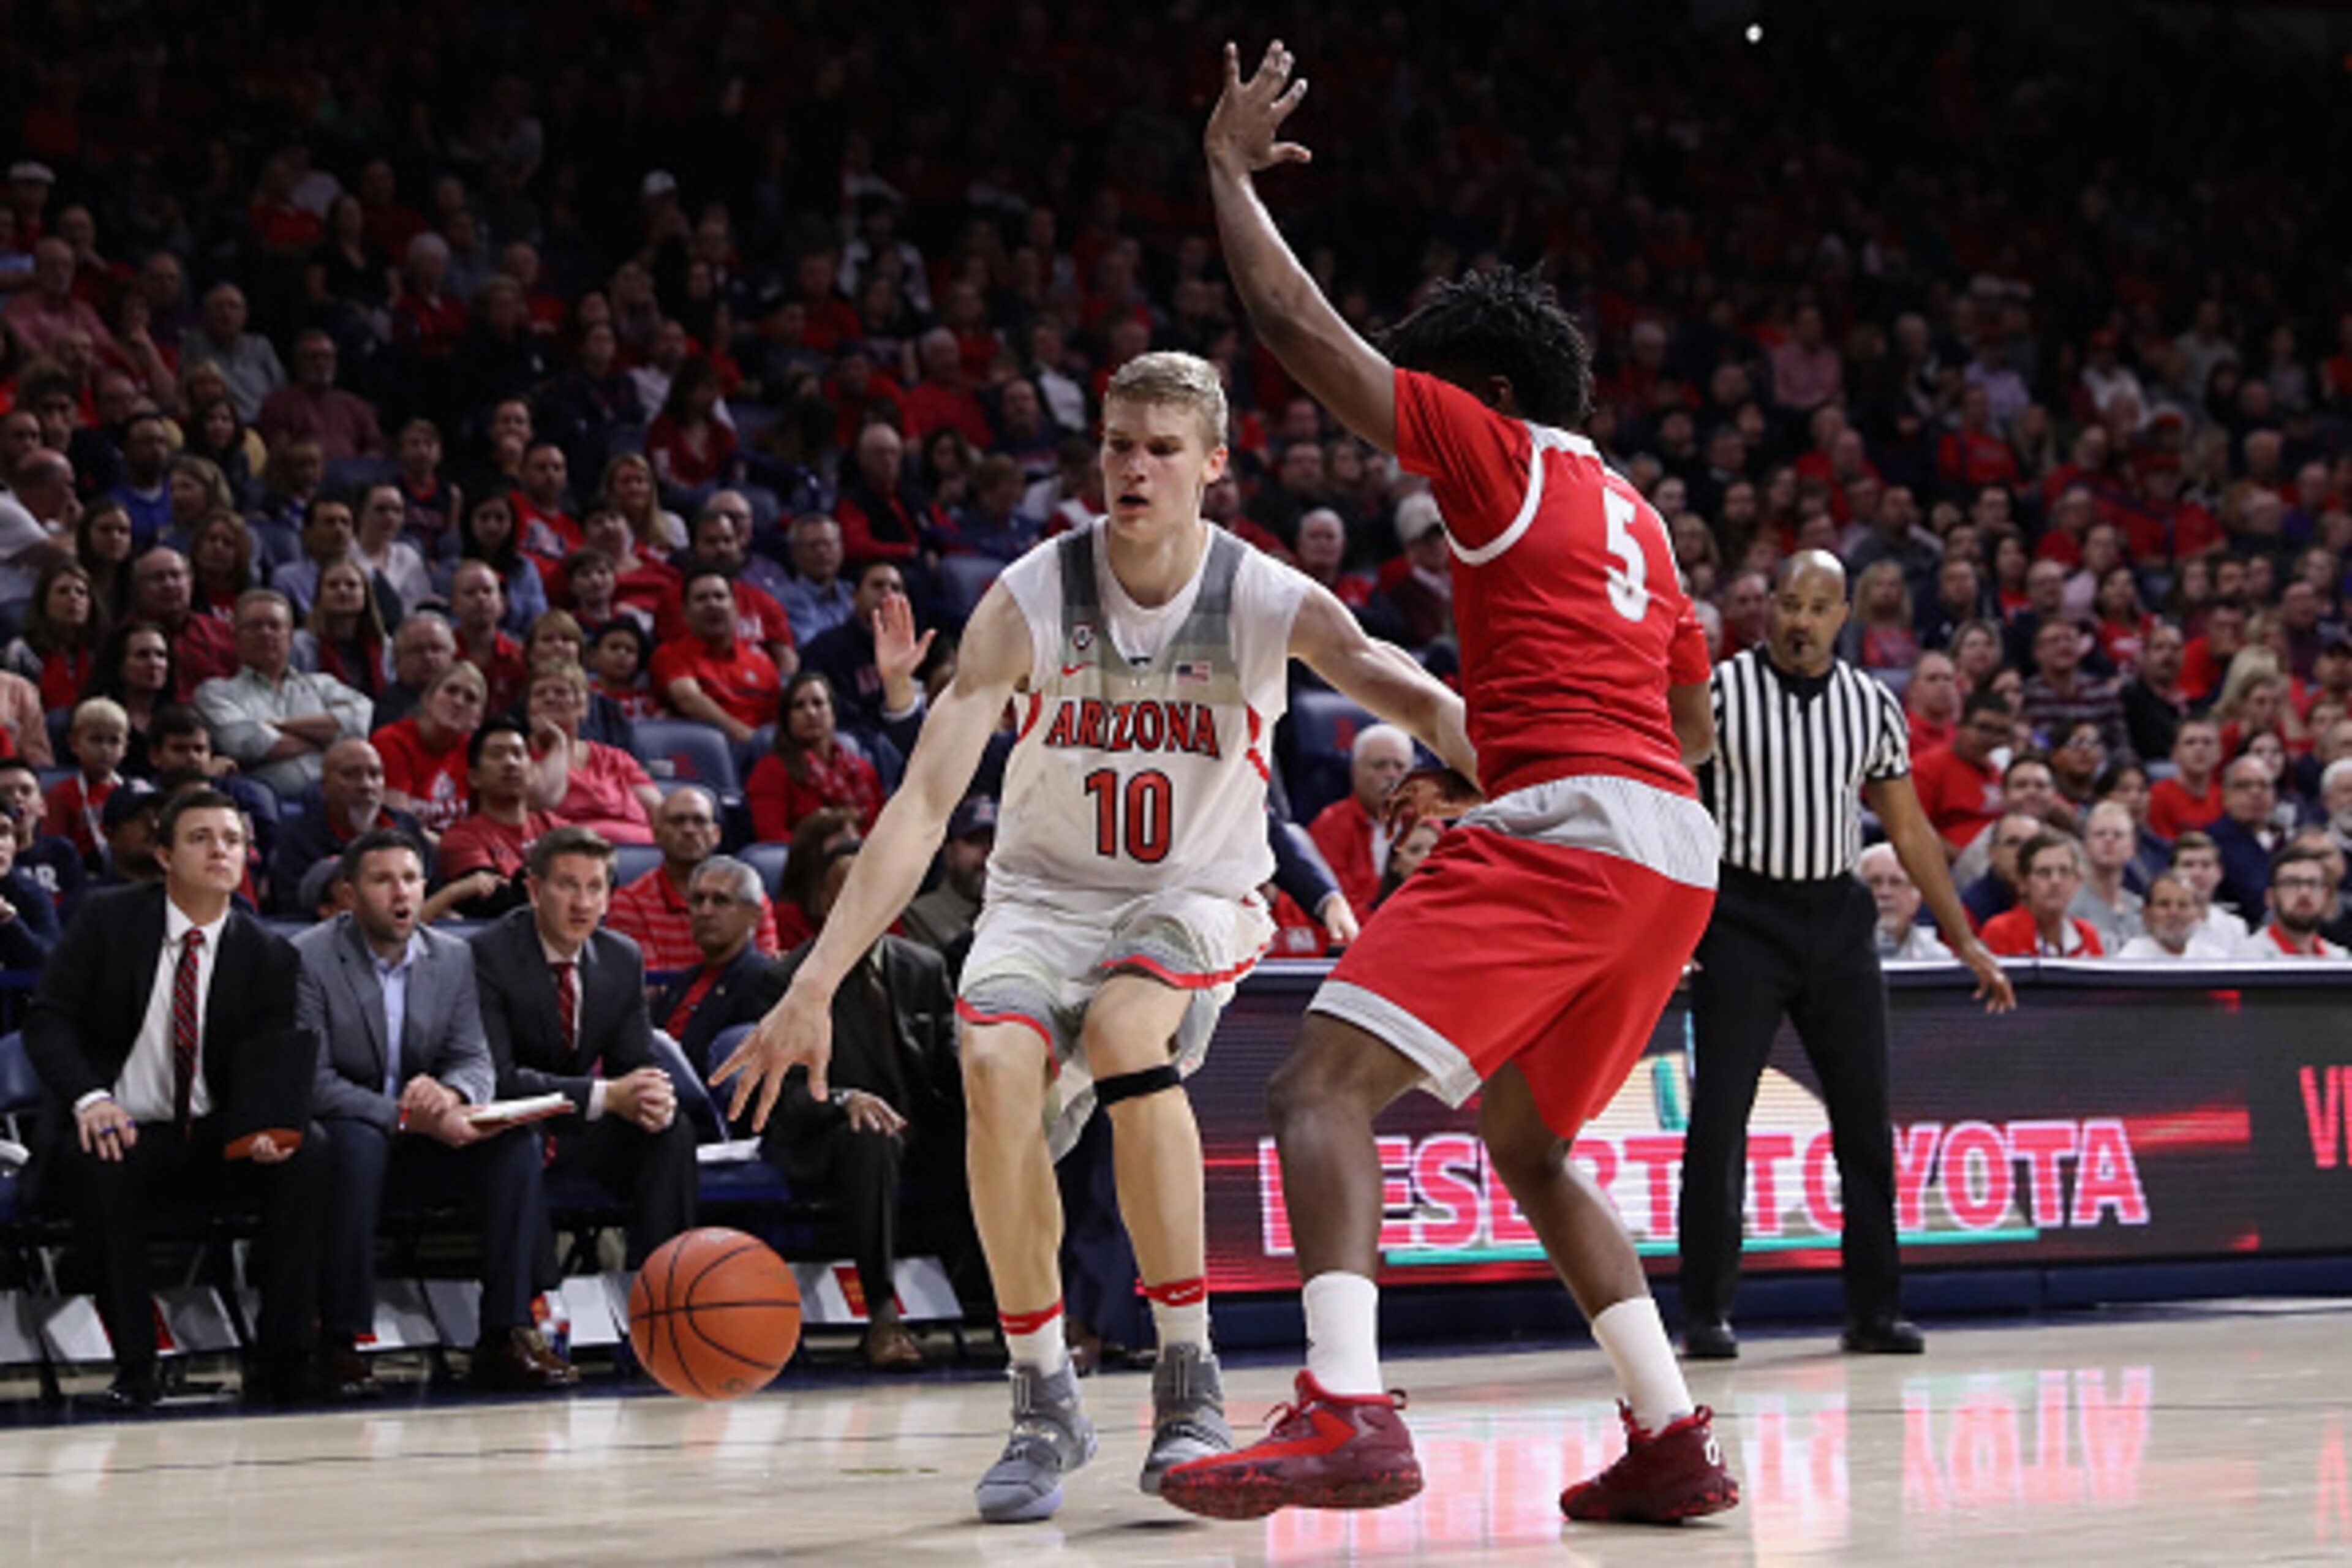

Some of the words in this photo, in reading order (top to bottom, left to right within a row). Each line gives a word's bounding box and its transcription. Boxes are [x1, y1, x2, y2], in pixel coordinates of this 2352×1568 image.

[1602, 487, 1649, 623] 5
[1043, 699, 1221, 761] ARIZONA
[1084, 767, 1173, 865] 10
[1259, 1132, 1684, 1256] EST
[1744, 1118, 2150, 1236] TOYOTA
